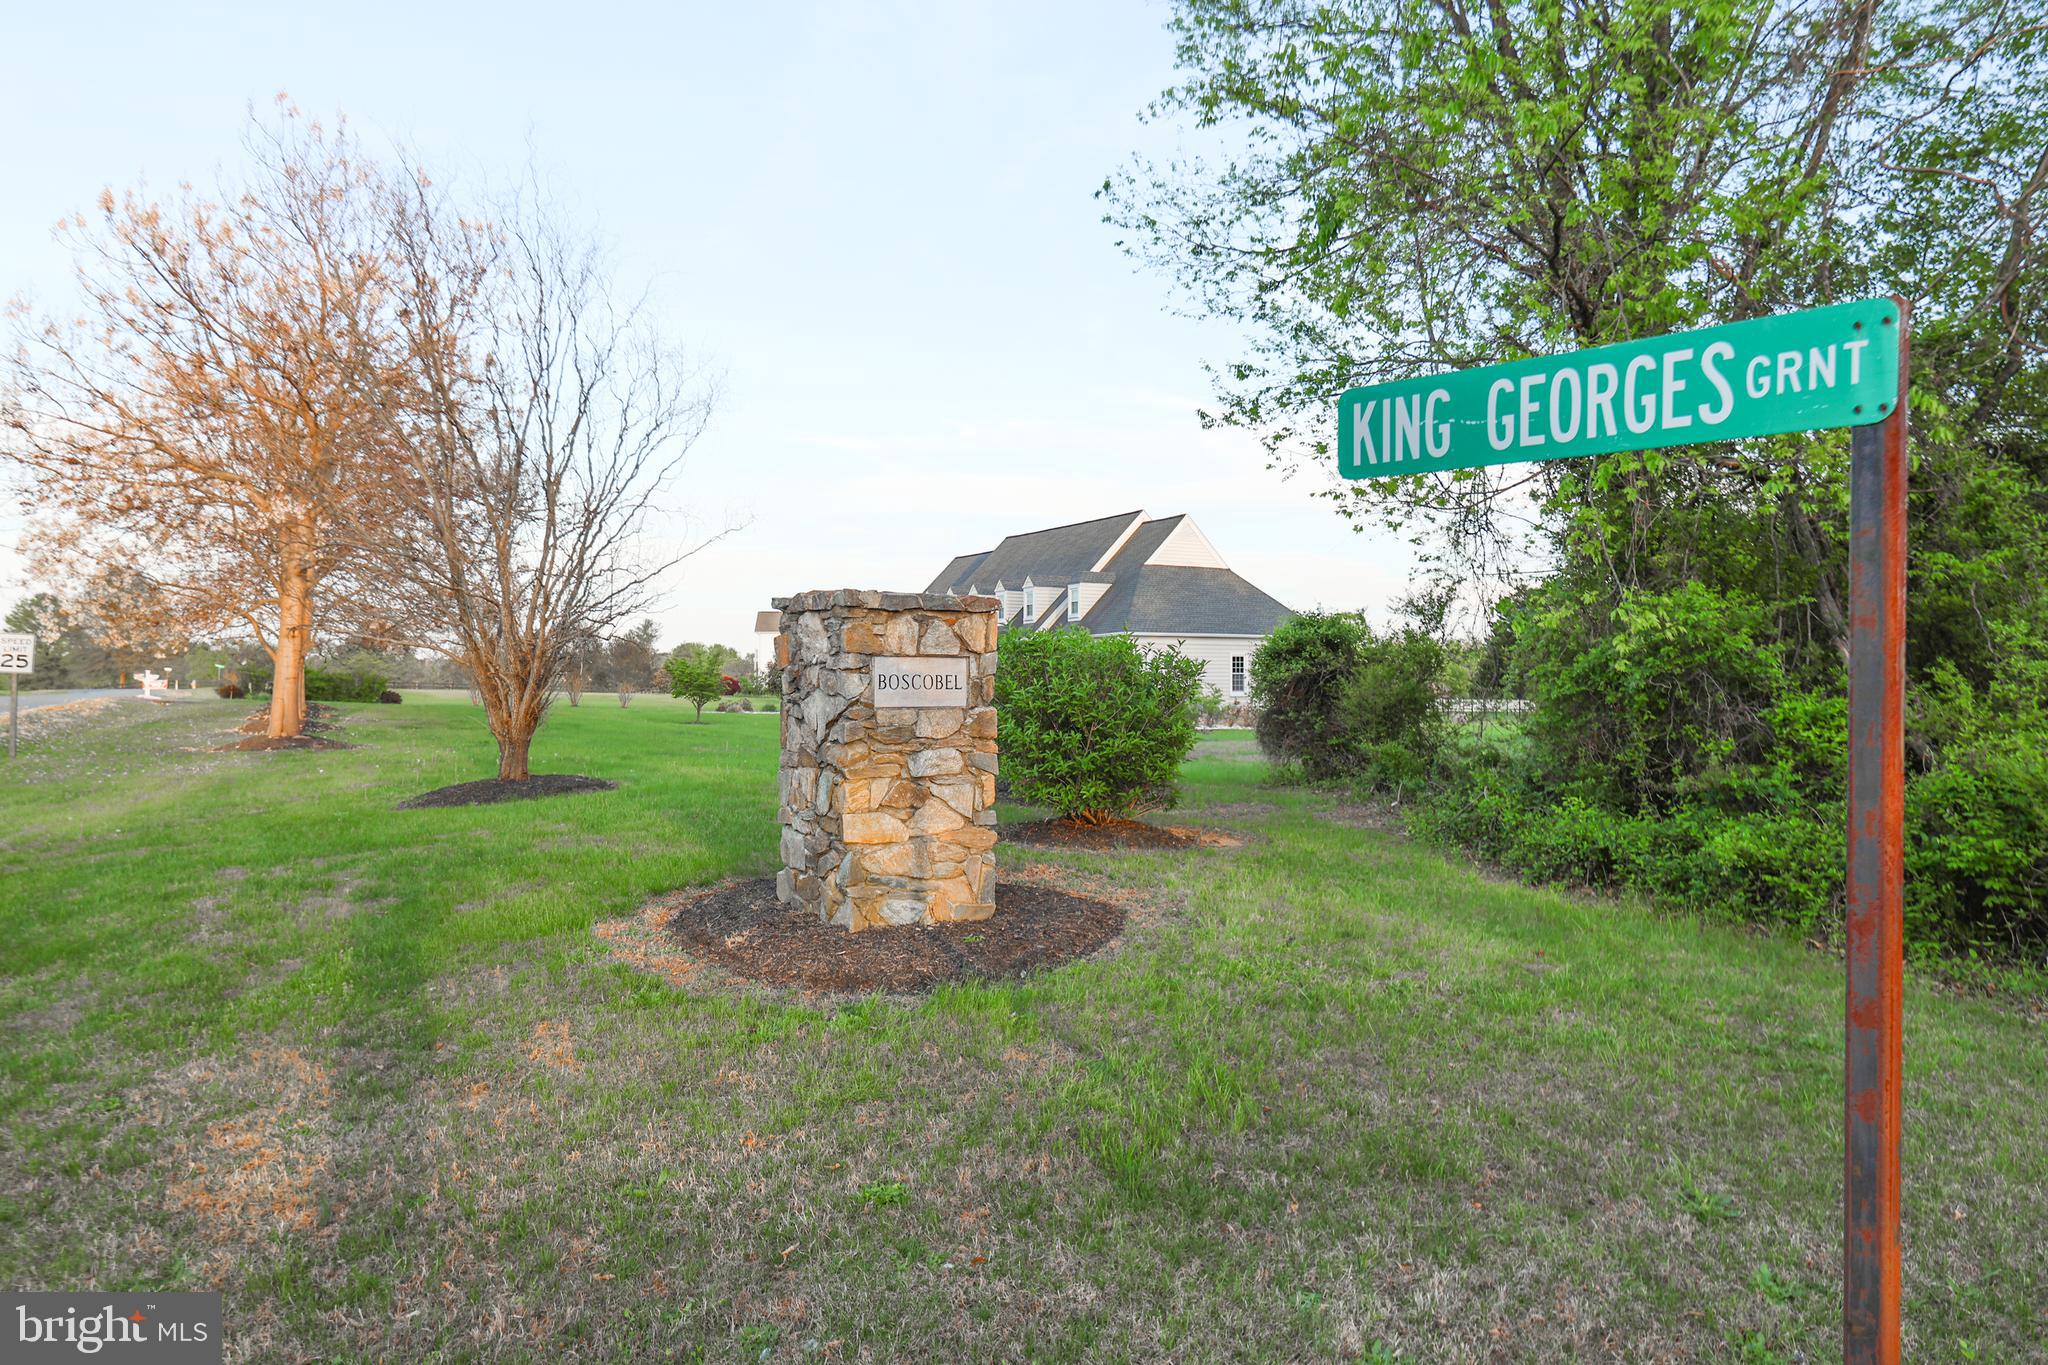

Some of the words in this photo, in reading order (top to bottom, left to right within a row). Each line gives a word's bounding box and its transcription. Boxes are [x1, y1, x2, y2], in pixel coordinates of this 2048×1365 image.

[1352, 388, 1451, 467] KING
[1487, 341, 1736, 451] GEORGES
[1746, 339, 1869, 400] GRNT
[1, 653, 28, 668] 25
[878, 674, 962, 690] BOSCOBEL
